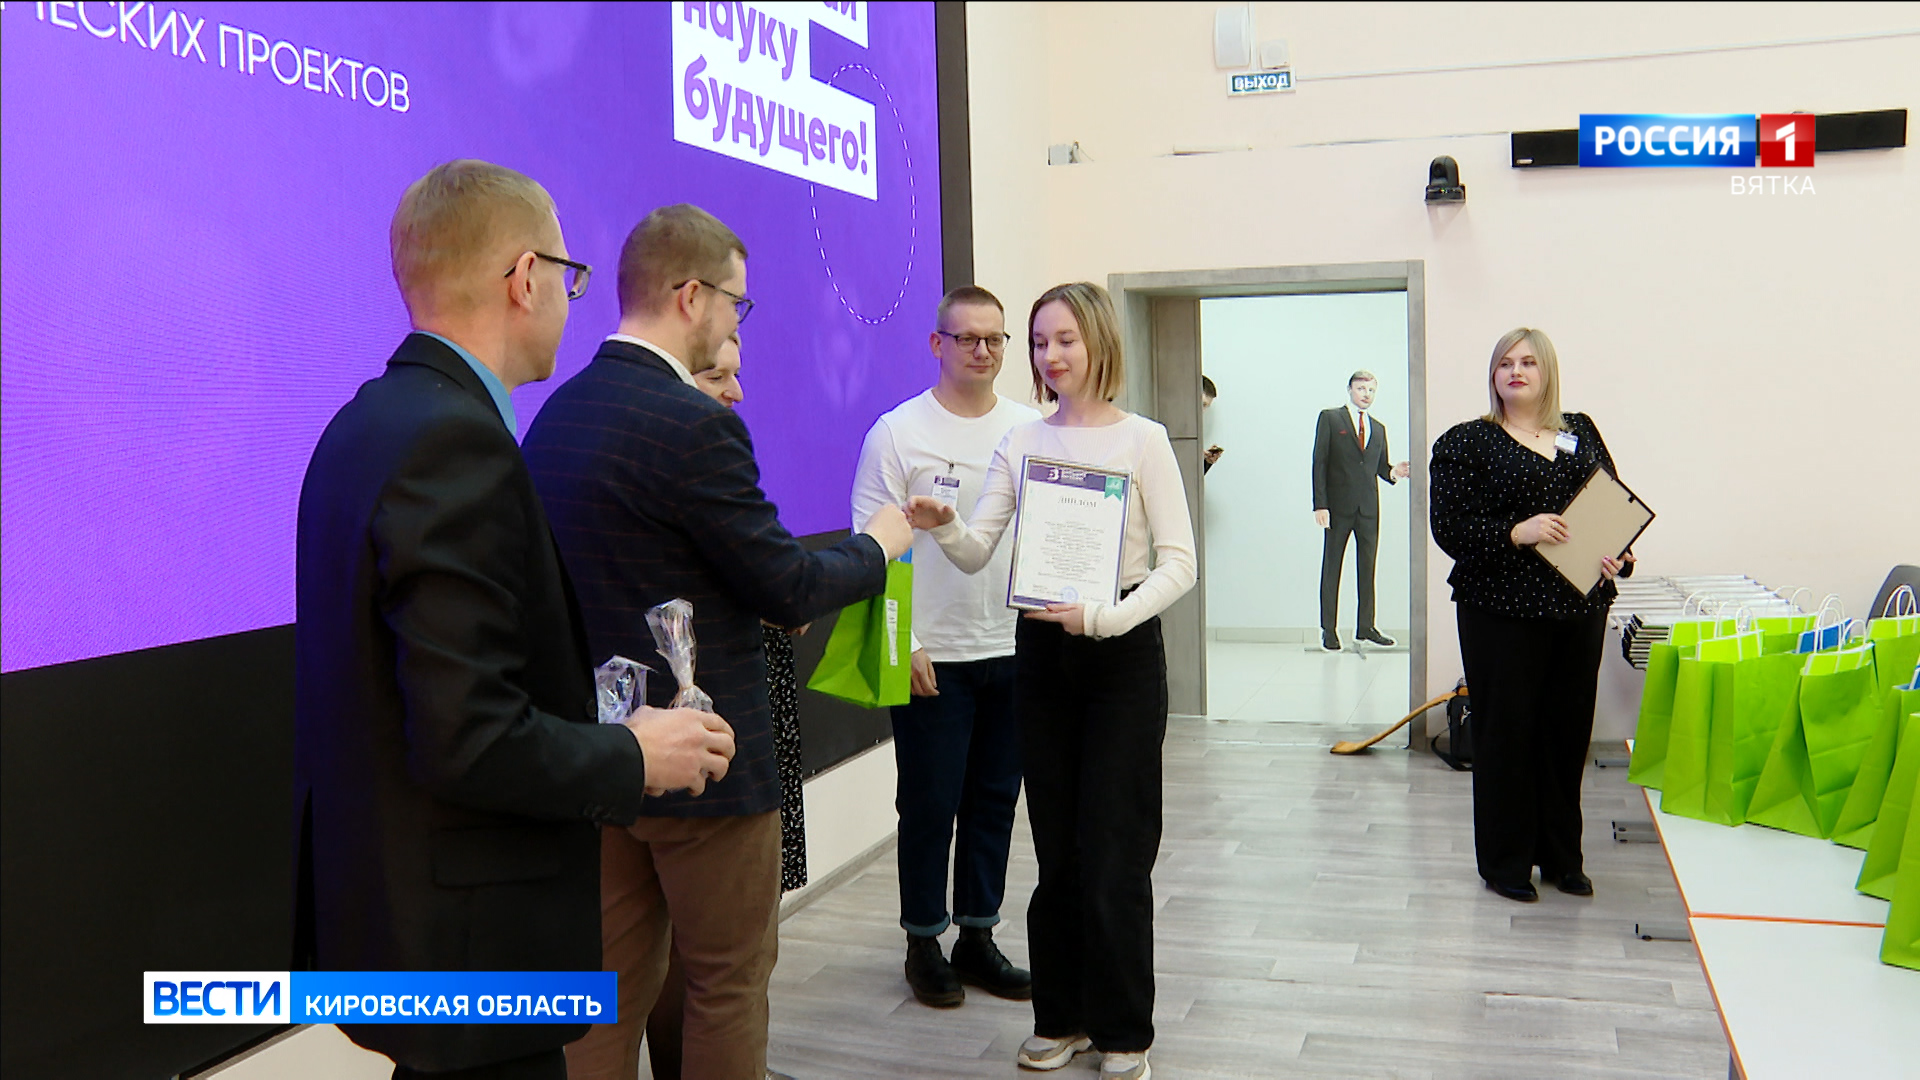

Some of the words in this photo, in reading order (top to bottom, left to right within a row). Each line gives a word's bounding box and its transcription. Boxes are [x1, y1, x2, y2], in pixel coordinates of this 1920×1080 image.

[217, 22, 410, 113] ПРОЕКТОВ
[1234, 73, 1289, 91] ВЫХОД
[684, 54, 868, 176] будущего!
